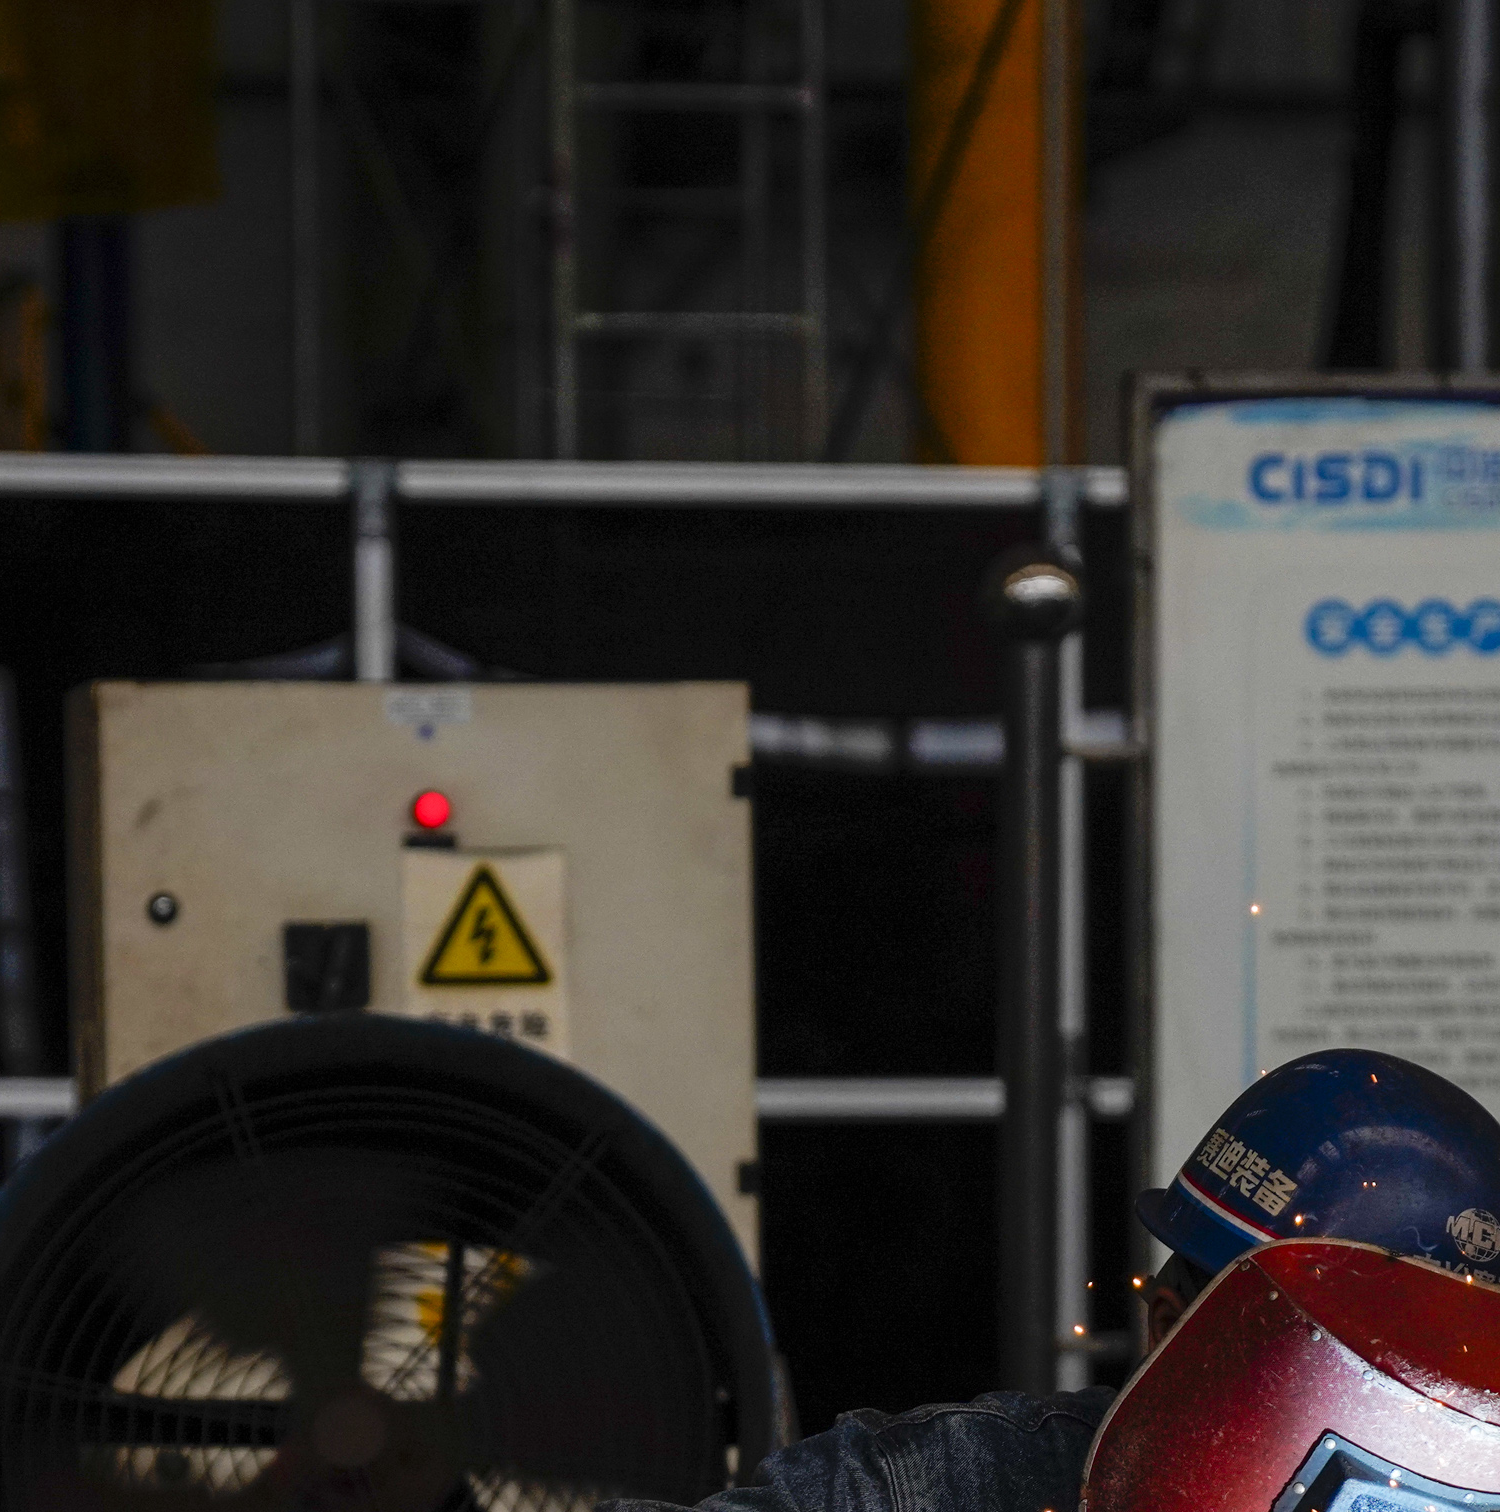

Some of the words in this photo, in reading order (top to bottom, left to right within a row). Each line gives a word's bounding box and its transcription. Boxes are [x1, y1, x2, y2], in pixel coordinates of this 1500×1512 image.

[1249, 451, 1426, 506] CISDI
[1196, 1127, 1298, 1217] 赛迪装备
